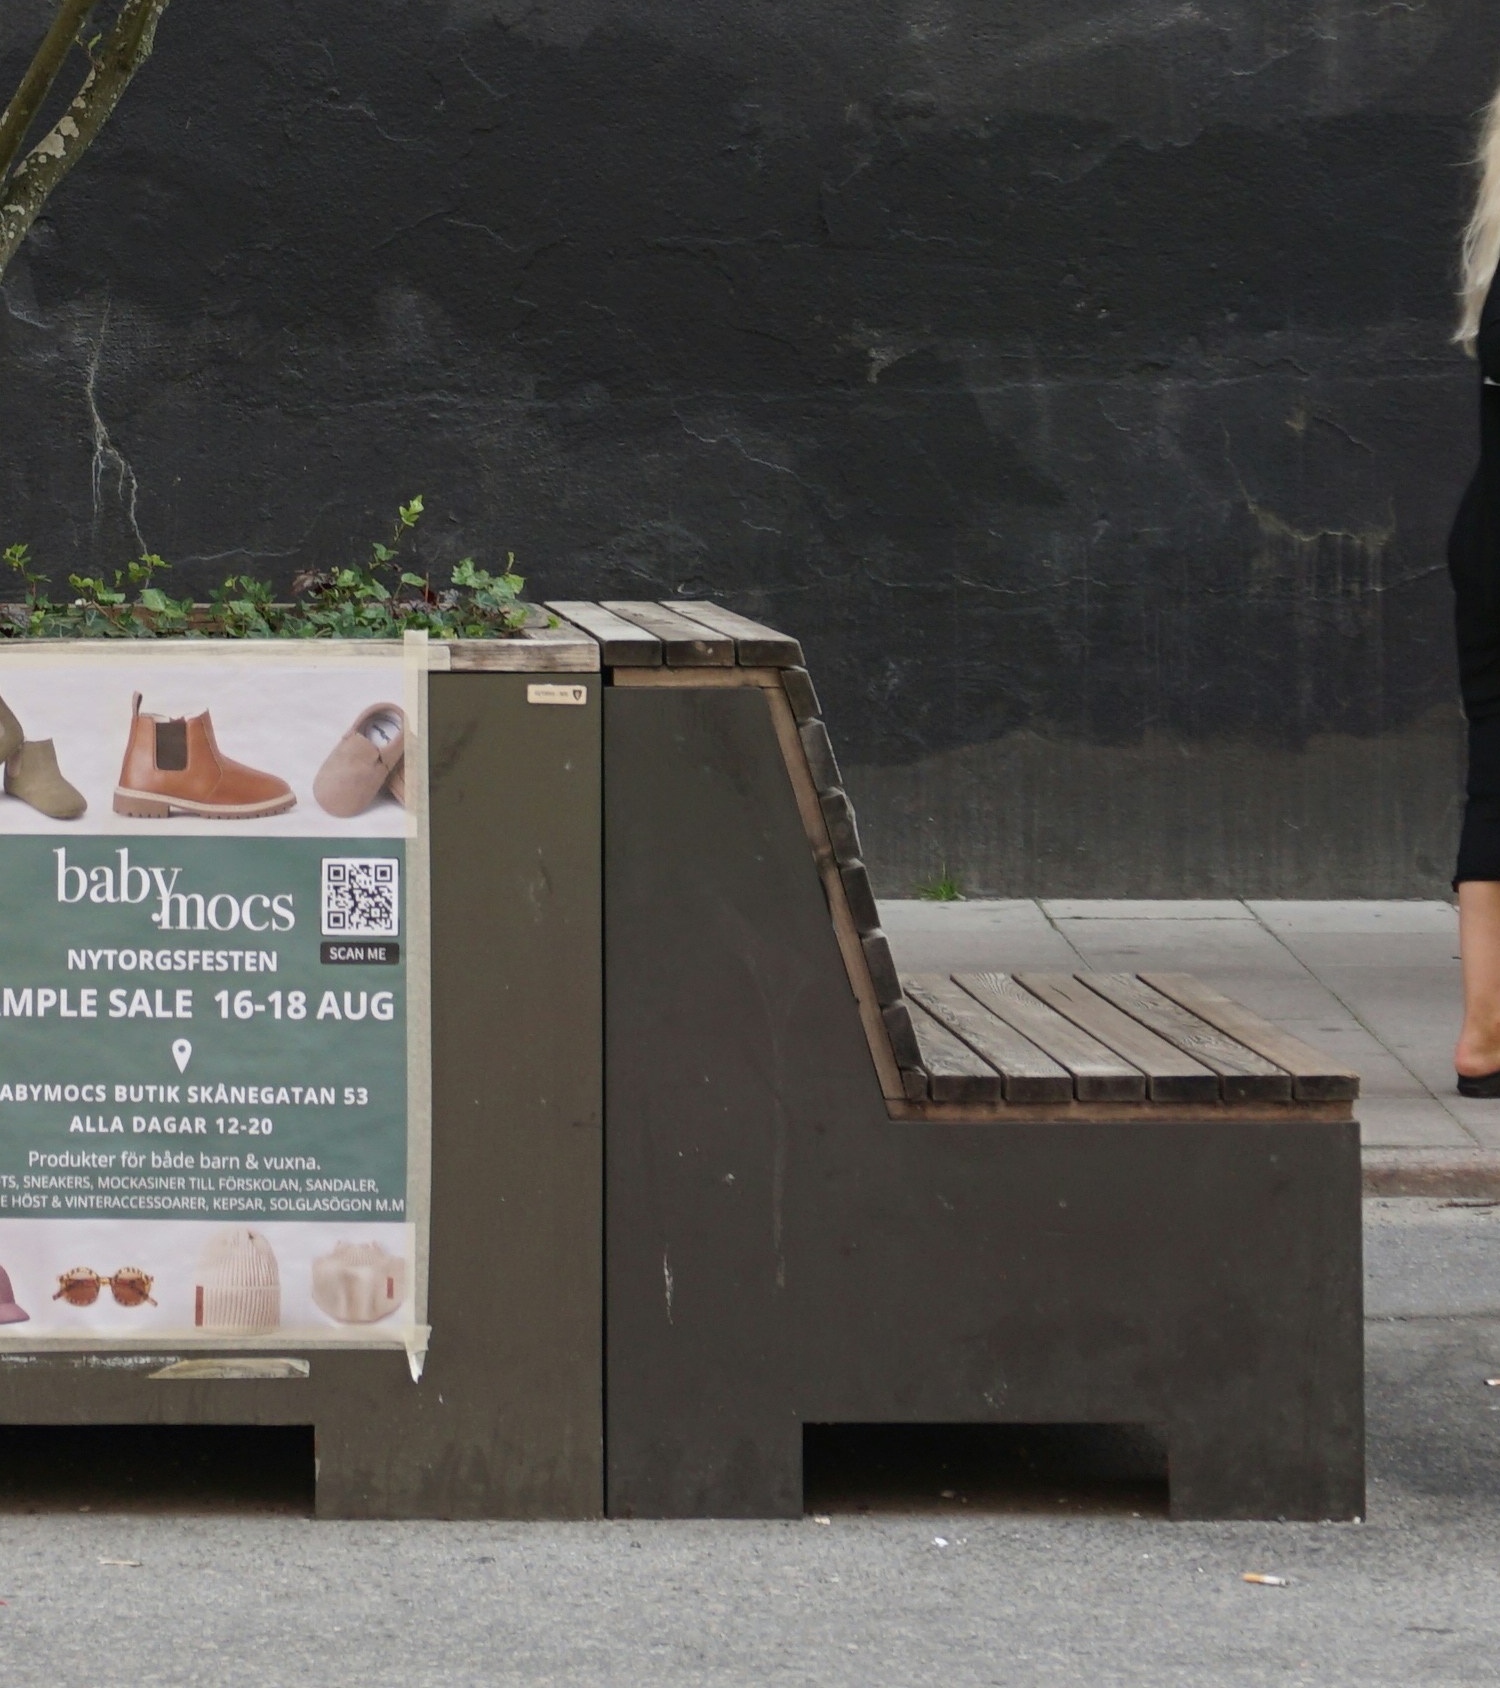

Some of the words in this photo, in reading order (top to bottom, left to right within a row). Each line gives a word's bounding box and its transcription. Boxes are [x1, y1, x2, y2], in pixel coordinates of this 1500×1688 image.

[67, 948, 279, 973] NYTORGSFESTEN
[328, 946, 364, 961] SCAN
[368, 946, 388, 962] ME
[108, 988, 194, 1019] SALE
[214, 989, 307, 1020] 16-18
[316, 990, 395, 1022] AUG
[114, 1085, 180, 1105] BUTIK
[187, 1079, 336, 1106] SKÅNEGATAN
[343, 1086, 369, 1106] 53
[69, 1115, 125, 1135] ALLA
[132, 1116, 207, 1136] DAGAR
[216, 1117, 274, 1136] 12-20
[28, 1150, 116, 1169] Produkter
[120, 1150, 145, 1169] för
[151, 1149, 195, 1170] både
[200, 1151, 240, 1170] barn
[245, 1152, 259, 1171] &
[263, 1156, 322, 1172] vuxna.
[23, 1176, 94, 1191] SNEAKERS,
[98, 1176, 186, 1190] MOCKASINER
[189, 1177, 215, 1191] TILL
[218, 1175, 302, 1193] FÖRSKOLAN,
[306, 1178, 380, 1194] SANDALER,
[12, 1191, 48, 1208] HÖST
[51, 1196, 62, 1209] &
[64, 1196, 209, 1212] VINTERACCESSOARER,
[213, 1197, 266, 1212] KEPSAR,
[269, 1196, 372, 1212] SOLGLASÖGON
